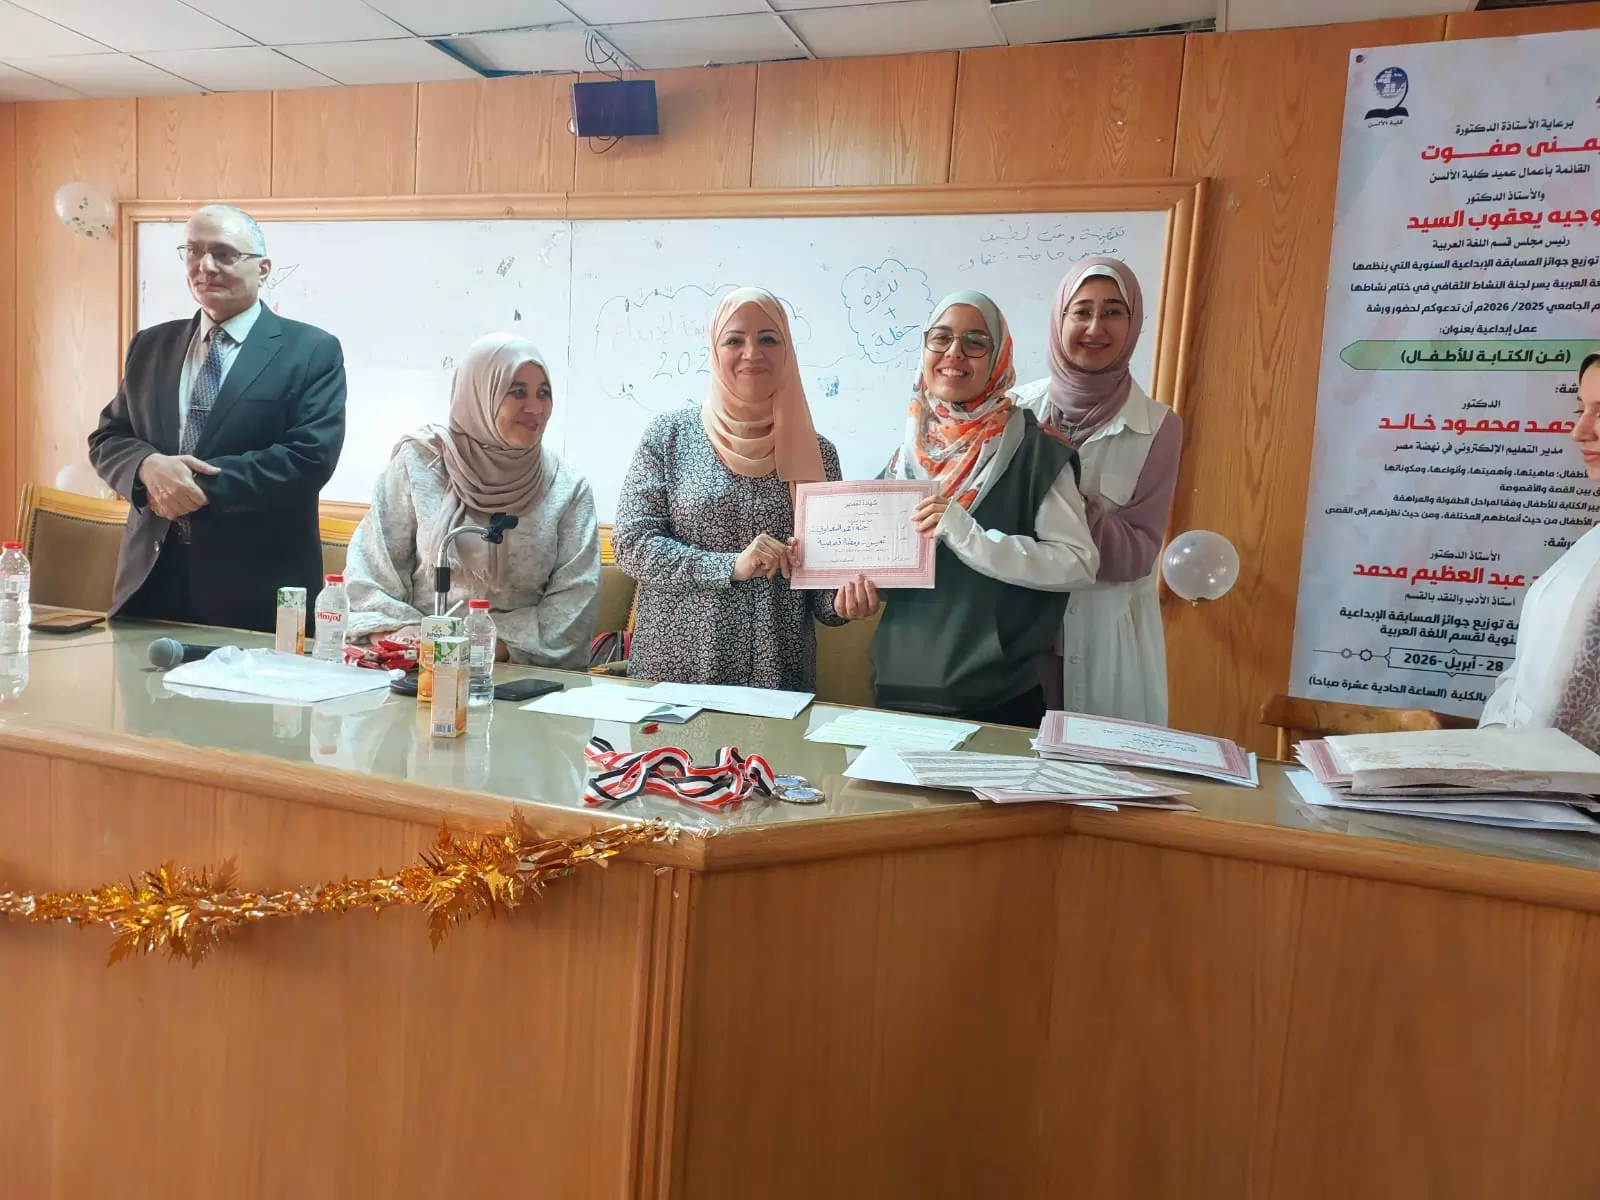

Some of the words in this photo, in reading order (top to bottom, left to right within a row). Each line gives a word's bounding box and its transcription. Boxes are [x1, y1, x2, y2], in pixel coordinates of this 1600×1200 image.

[1455, 123, 1499, 136] الدكتورة
[1501, 120, 1539, 131] الأستاذة
[1541, 119, 1574, 131] برعاية
[1421, 139, 1522, 164] صفوت
[1462, 169, 1489, 179] كلية
[1491, 170, 1516, 180] عميد
[1518, 166, 1553, 179] بأعمال
[1555, 164, 1590, 174] القائمة
[1429, 171, 1460, 184] الألسن
[1465, 192, 1506, 205] الدكتور
[1508, 188, 1545, 202] والأستاذ
[1407, 210, 1465, 233] السيد
[1468, 208, 1543, 230] يعقوب
[1432, 239, 1465, 251] العربية
[1466, 238, 1489, 248] اللغة
[1490, 237, 1512, 249] قسم
[1513, 237, 1543, 249] مجلس
[1545, 236, 1570, 248] رئيس
[1352, 261, 1389, 272] ينظمها
[1389, 261, 1411, 274] التي
[1412, 260, 1450, 271] السنوية
[1451, 259, 1494, 270] الإبداعية
[1495, 257, 1543, 269] المسابقة
[1543, 257, 1569, 268] جوائز
[1571, 256, 1600, 269] توزيع
[1350, 282, 1387, 292] نشاطها
[1388, 282, 1411, 294] ختام
[1412, 282, 1430, 294] في
[1431, 280, 1471, 294] الثقافي
[1471, 280, 1506, 290] النشاط
[1507, 280, 1530, 291] لجنة
[1531, 282, 1550, 291] يسر
[1552, 278, 1588, 290] العربية
[1366, 303, 1391, 315] ورشة
[1391, 304, 1420, 315] لحضور
[1421, 303, 1461, 315] تدعوكم
[1461, 301, 1473, 313] أن
[1546, 301, 1590, 314] الجامعي
[1439, 325, 1475, 336] بعنوان:
[1476, 324, 1512, 336] إبداعية
[1513, 324, 1537, 334] عمل
[1476, 349, 1534, 366] الكتابة
[1461, 399, 1501, 410] الدكتور
[1378, 413, 1437, 430] خالد
[1441, 419, 1520, 435] محمود
[1393, 444, 1413, 452] مصر
[1416, 441, 1440, 453] نهضة
[1441, 442, 1453, 455] في
[1454, 443, 1504, 455] الإلكتروني
[1506, 445, 1538, 456] التعليم
[1540, 447, 1563, 457] مدير
[1499, 483, 1547, 494] والأقصوصة
[1548, 485, 1575, 494] القصة
[1576, 487, 1592, 496] بين
[1393, 494, 1435, 505] والمراهقة
[1436, 496, 1470, 505] الطفولة
[1523, 499, 1558, 509] للأطفال
[1325, 506, 1353, 514] القصص
[1354, 507, 1368, 517] إلى
[1559, 502, 1588, 511] الكتابة
[1368, 508, 1401, 518] نظرتهم
[1401, 509, 1420, 519] حيث
[1421, 511, 1440, 520] ومن
[1481, 513, 1522, 523] أنماطهم
[1522, 515, 1542, 525] حيث
[1543, 517, 1558, 525] من
[1429, 549, 1467, 560] الدكتور
[1469, 551, 1500, 561] الأستاذ
[1353, 564, 1408, 579] محمد
[1411, 565, 1484, 586] العظيم
[1487, 573, 1525, 590] عبد
[1405, 591, 1435, 603] بالقسم
[1437, 593, 1463, 605] والنقد
[1465, 593, 1490, 606] الأدب
[1339, 607, 1387, 623] الإبداعية
[1388, 611, 1440, 624] المسابقة
[1441, 614, 1470, 629] جوائز
[1472, 618, 1505, 631] توزيع
[1380, 625, 1417, 638] العربية
[1419, 628, 1448, 639] اللغة
[1448, 632, 1485, 643] لقسم
[1486, 660, 1504, 672] 28
[1341, 679, 1369, 691] عشرة
[1371, 682, 1407, 694] الحادية
